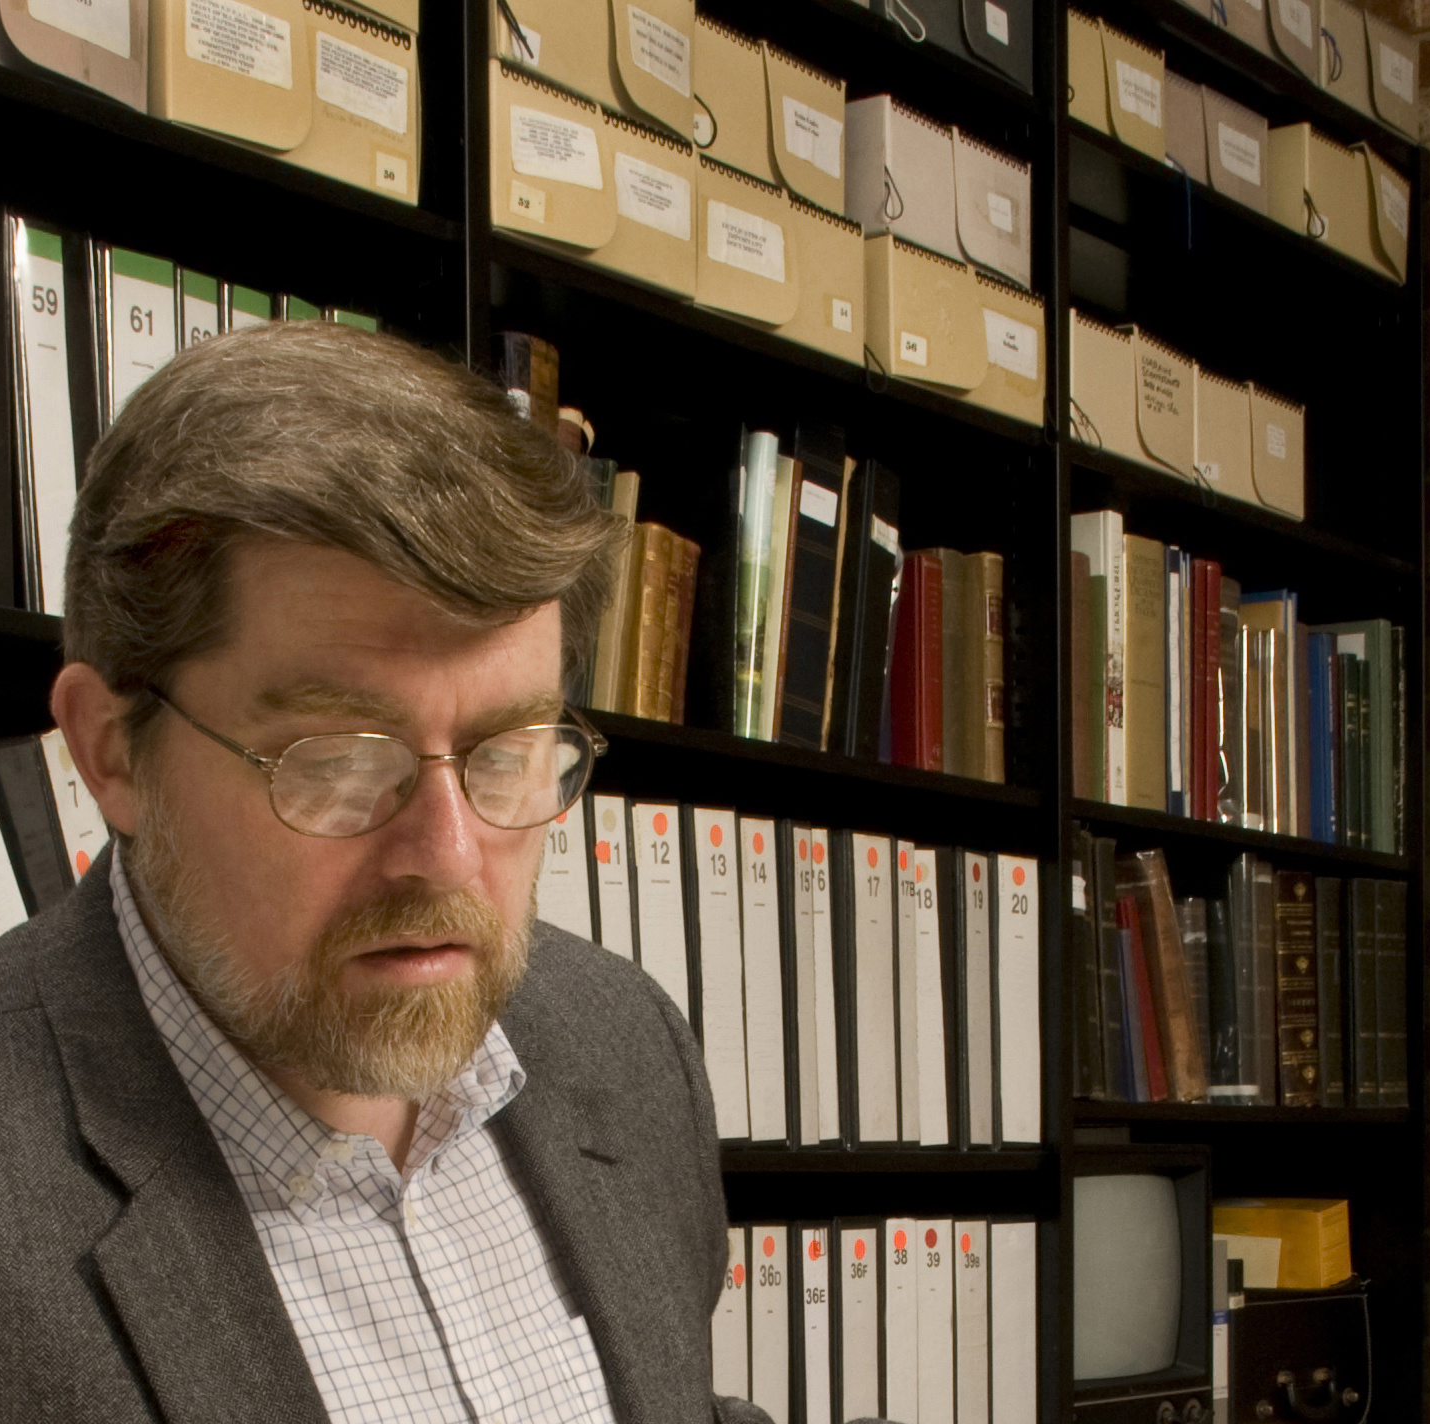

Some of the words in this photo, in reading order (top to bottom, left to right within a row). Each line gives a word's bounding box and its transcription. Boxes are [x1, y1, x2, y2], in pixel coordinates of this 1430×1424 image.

[32, 286, 57, 315] 59
[130, 305, 153, 337] 61
[68, 781, 79, 808] 7
[549, 830, 568, 855] 10
[651, 841, 670, 865] 12
[710, 853, 727, 877] 13
[751, 861, 767, 885] 14
[800, 870, 810, 893] 15
[867, 876, 880, 898] 17
[916, 888, 933, 910] 18
[972, 889, 984, 910] 19
[1011, 893, 1028, 915] 20
[893, 1249, 908, 1266] 38
[926, 1252, 941, 1268] 39
[759, 1264, 782, 1287] 36D
[850, 1262, 868, 1279] 36F
[805, 1287, 826, 1305] 36E
